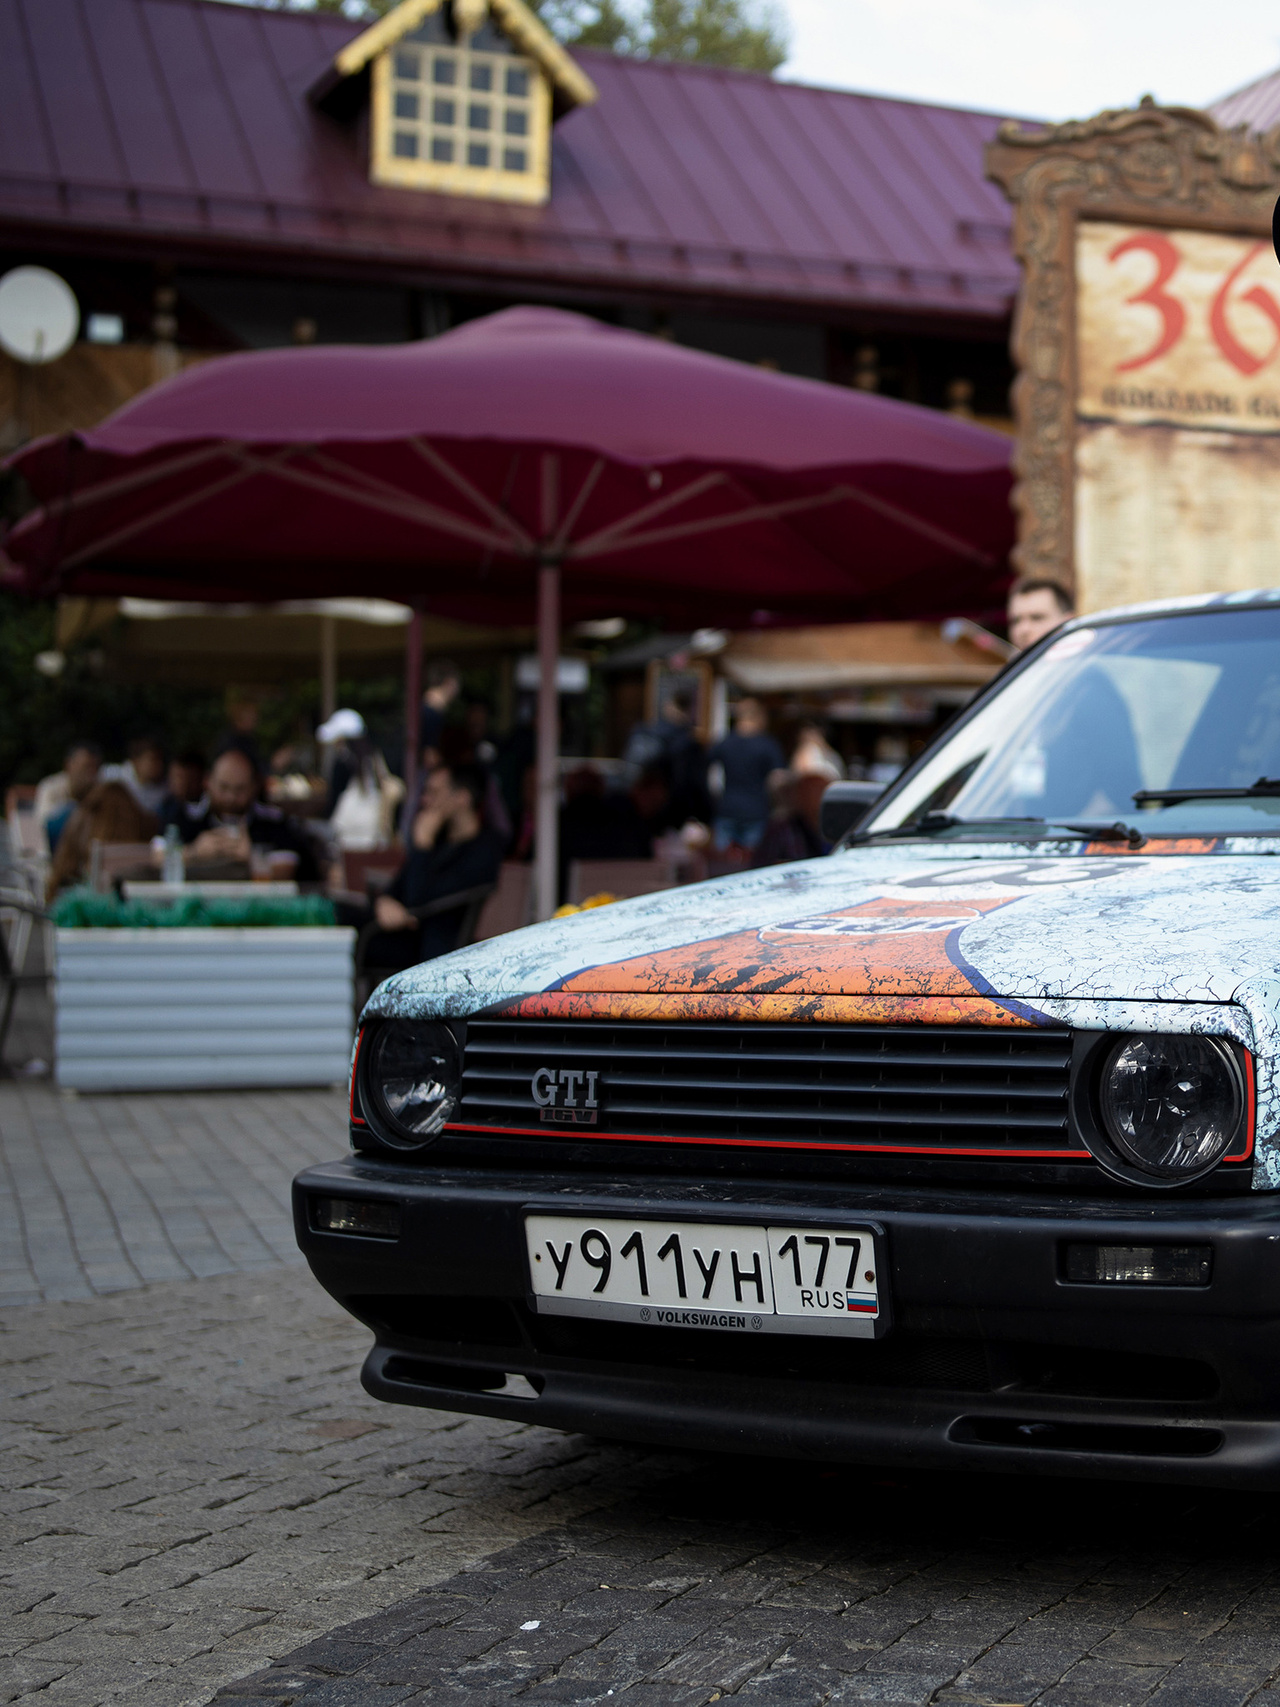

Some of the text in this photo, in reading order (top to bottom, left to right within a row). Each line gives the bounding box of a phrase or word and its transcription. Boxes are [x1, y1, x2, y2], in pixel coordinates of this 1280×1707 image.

[532, 1068, 598, 1107] GTI
[541, 1108, 597, 1123] 16V
[778, 1234, 861, 1288] 177
[801, 1290, 844, 1310] RUS
[657, 1311, 745, 1328] VOLKSWAGEN
